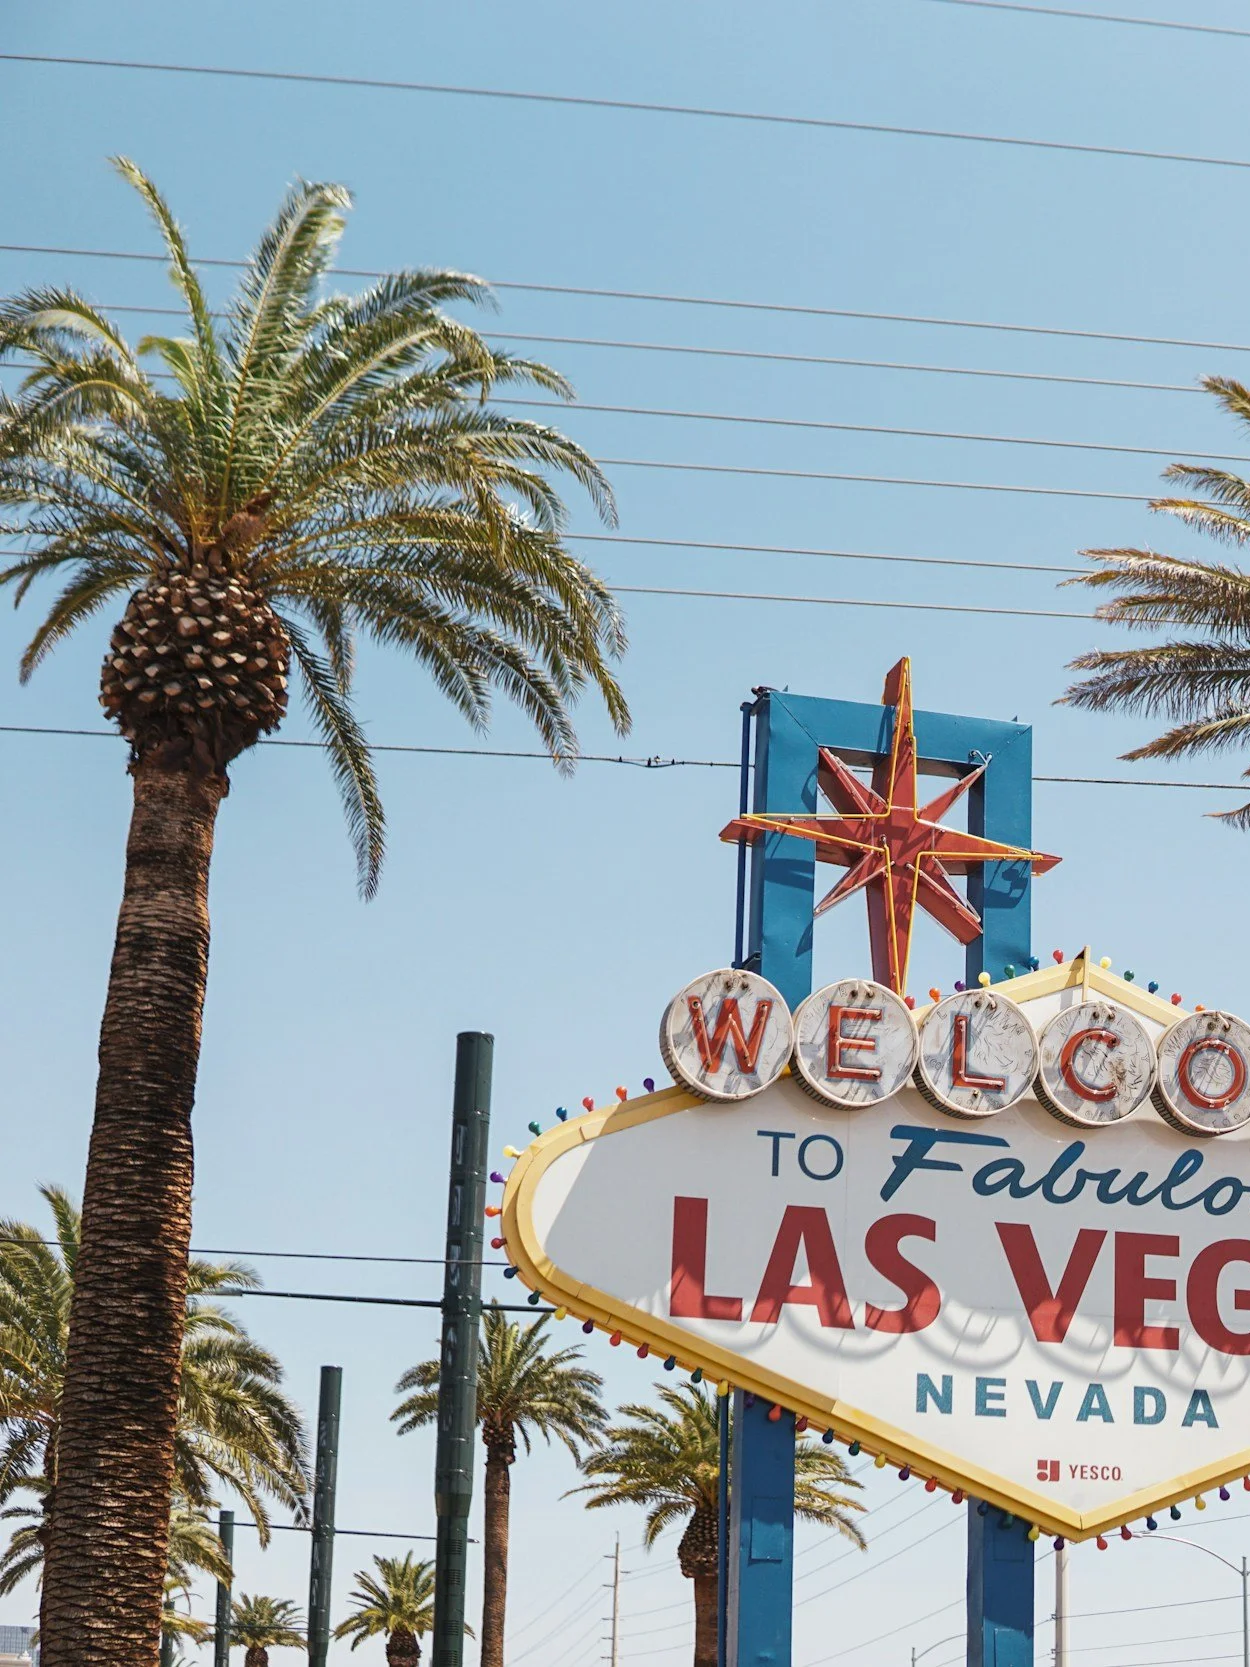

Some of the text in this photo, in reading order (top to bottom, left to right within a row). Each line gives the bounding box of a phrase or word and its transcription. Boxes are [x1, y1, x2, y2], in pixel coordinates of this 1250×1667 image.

[756, 1128, 845, 1181] TO
[668, 1195, 942, 1334] LAS
[915, 1372, 1220, 1429] NEVADA
[1069, 1464, 1122, 1482] YESCO
